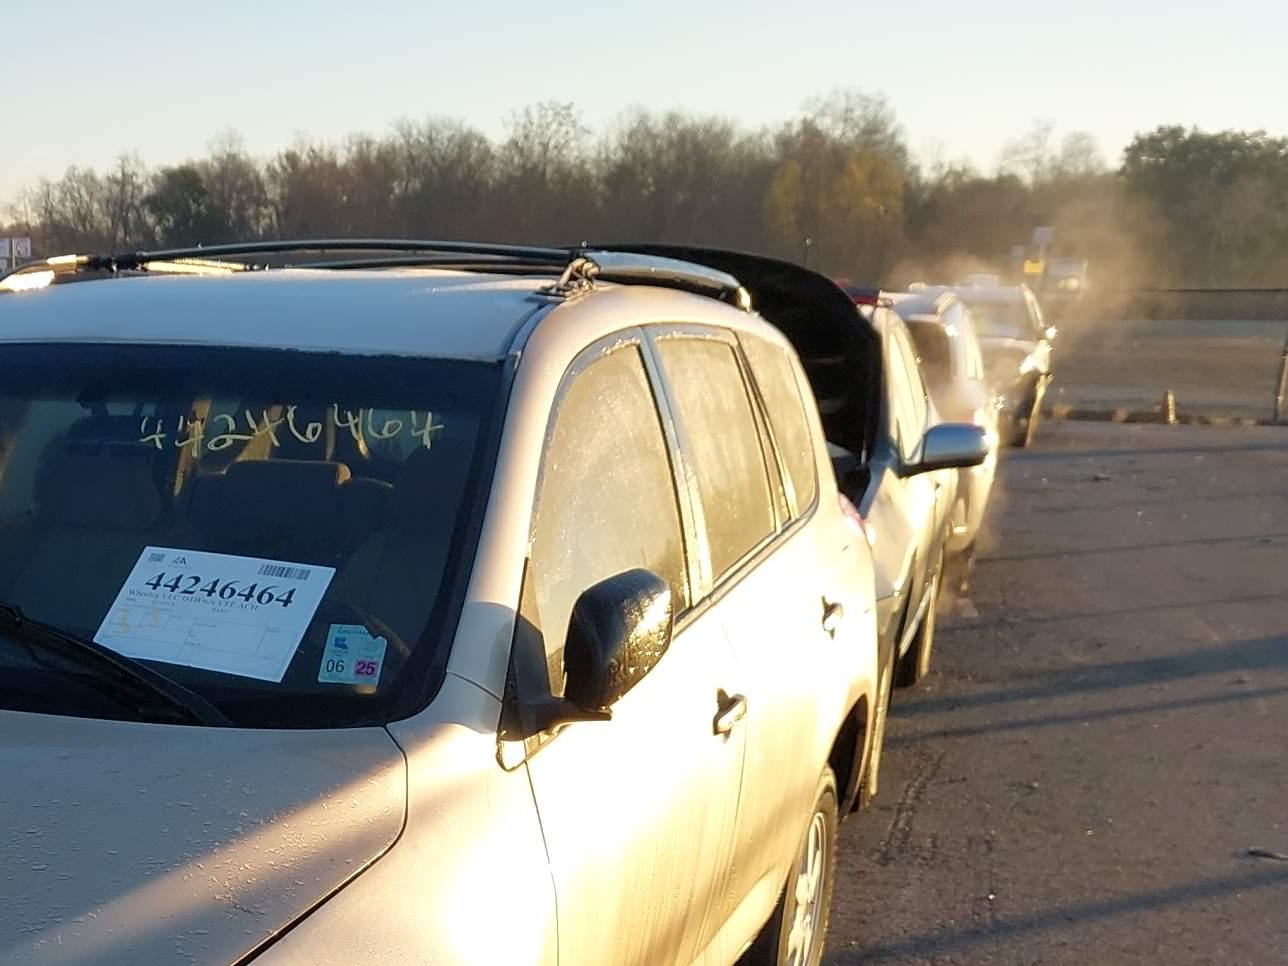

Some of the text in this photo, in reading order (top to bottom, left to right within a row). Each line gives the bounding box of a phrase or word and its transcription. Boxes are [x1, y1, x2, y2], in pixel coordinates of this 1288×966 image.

[140, 404, 444, 457] 44246464
[145, 571, 297, 608] 44246464
[326, 659, 377, 676] 06 25
